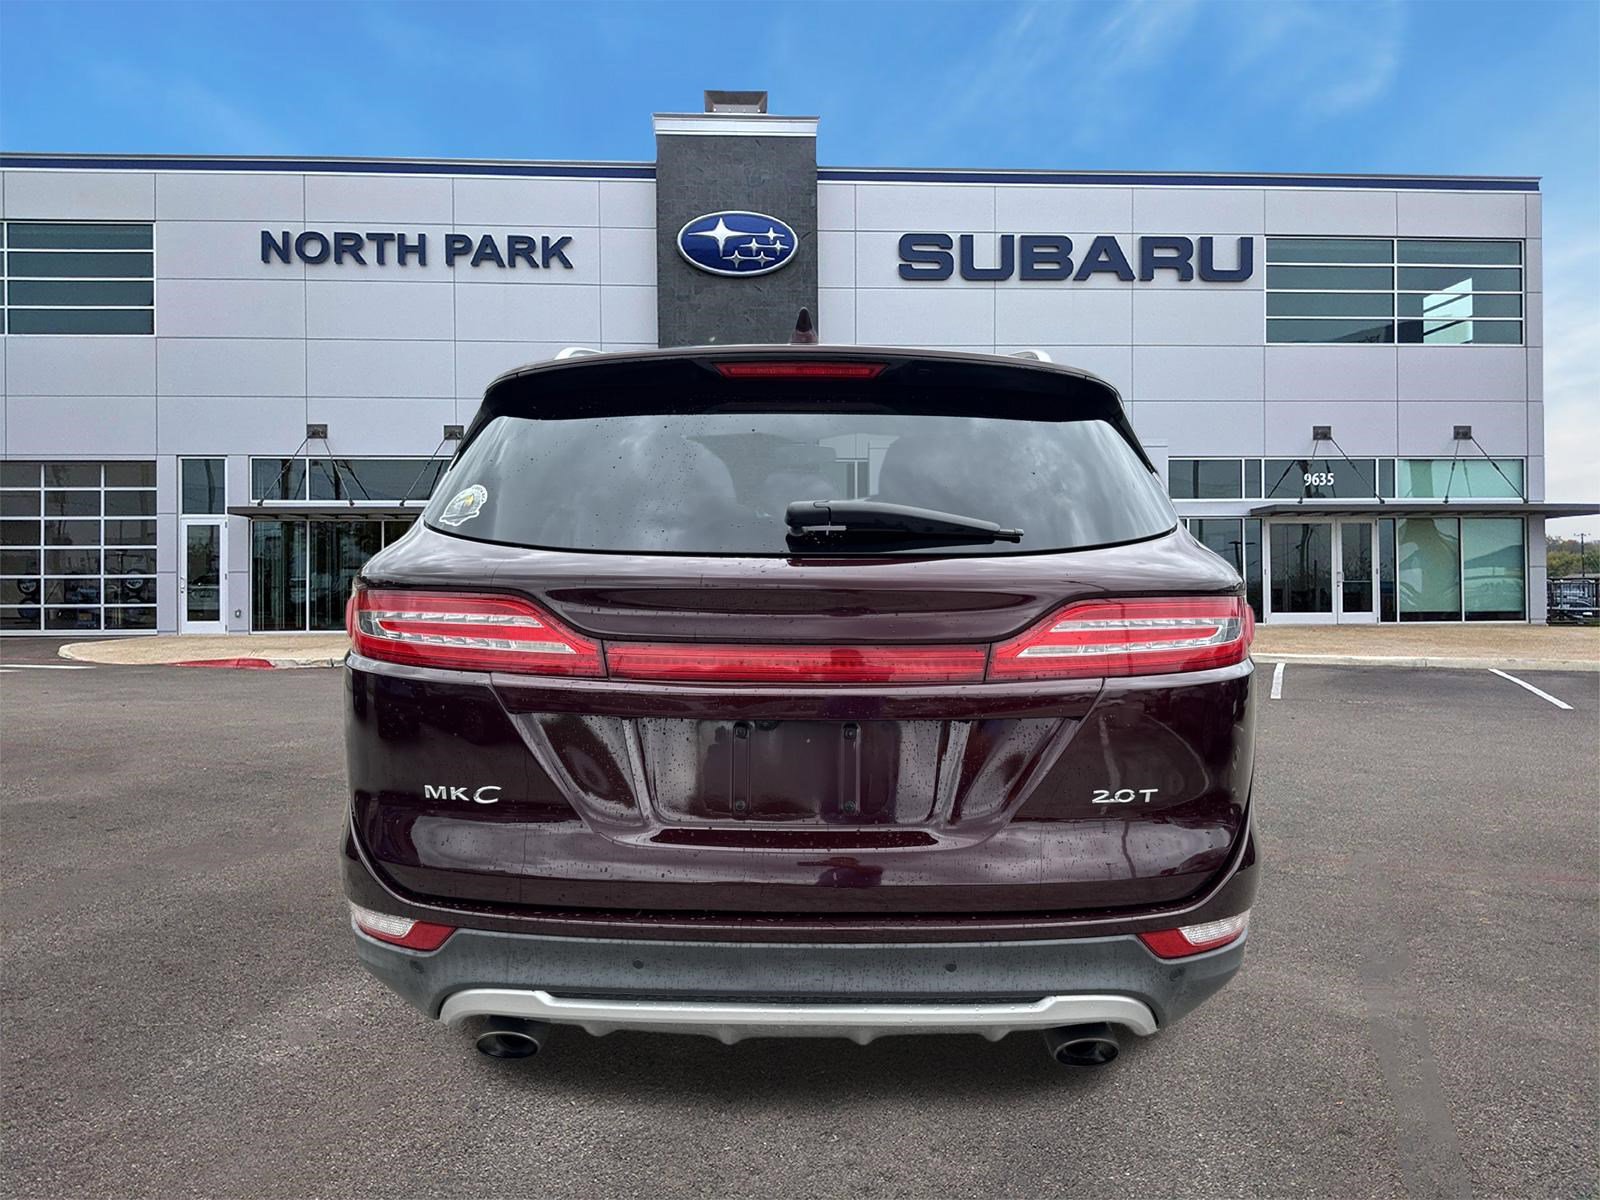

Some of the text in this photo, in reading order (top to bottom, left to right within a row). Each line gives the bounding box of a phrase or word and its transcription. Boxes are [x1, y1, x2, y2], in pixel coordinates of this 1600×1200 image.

[261, 230, 574, 269] NORTH PARK
[898, 233, 1254, 282] SUBARU
[1303, 472, 1335, 486] 9635
[423, 784, 502, 804] MKC
